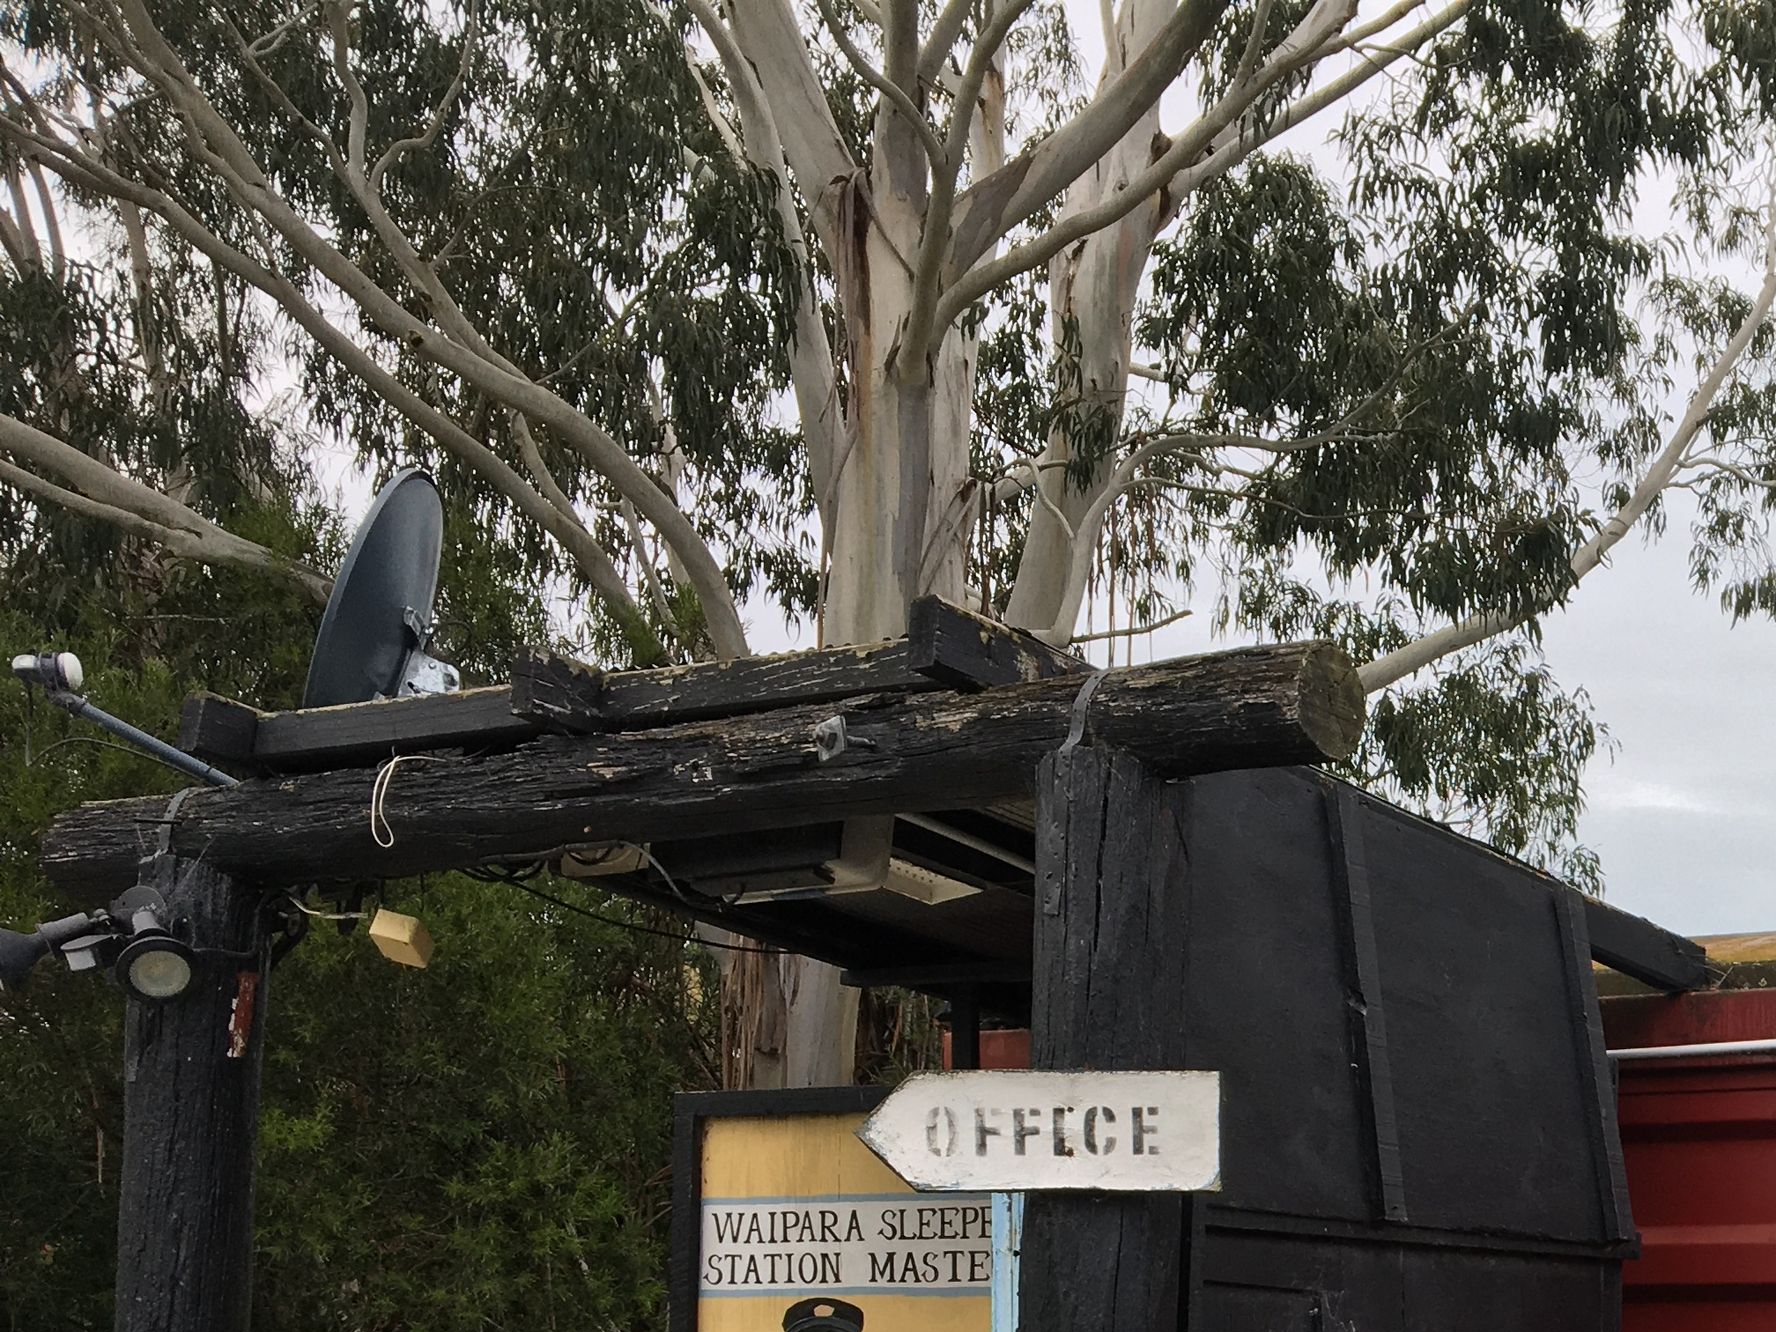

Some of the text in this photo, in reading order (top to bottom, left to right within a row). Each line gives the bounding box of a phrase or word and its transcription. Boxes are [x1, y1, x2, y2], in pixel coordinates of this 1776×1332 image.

[926, 1106, 1160, 1157] OFFICE
[712, 1206, 992, 1243] WAIPARA SLEEPE
[703, 1250, 991, 1285] STATION MASTE
